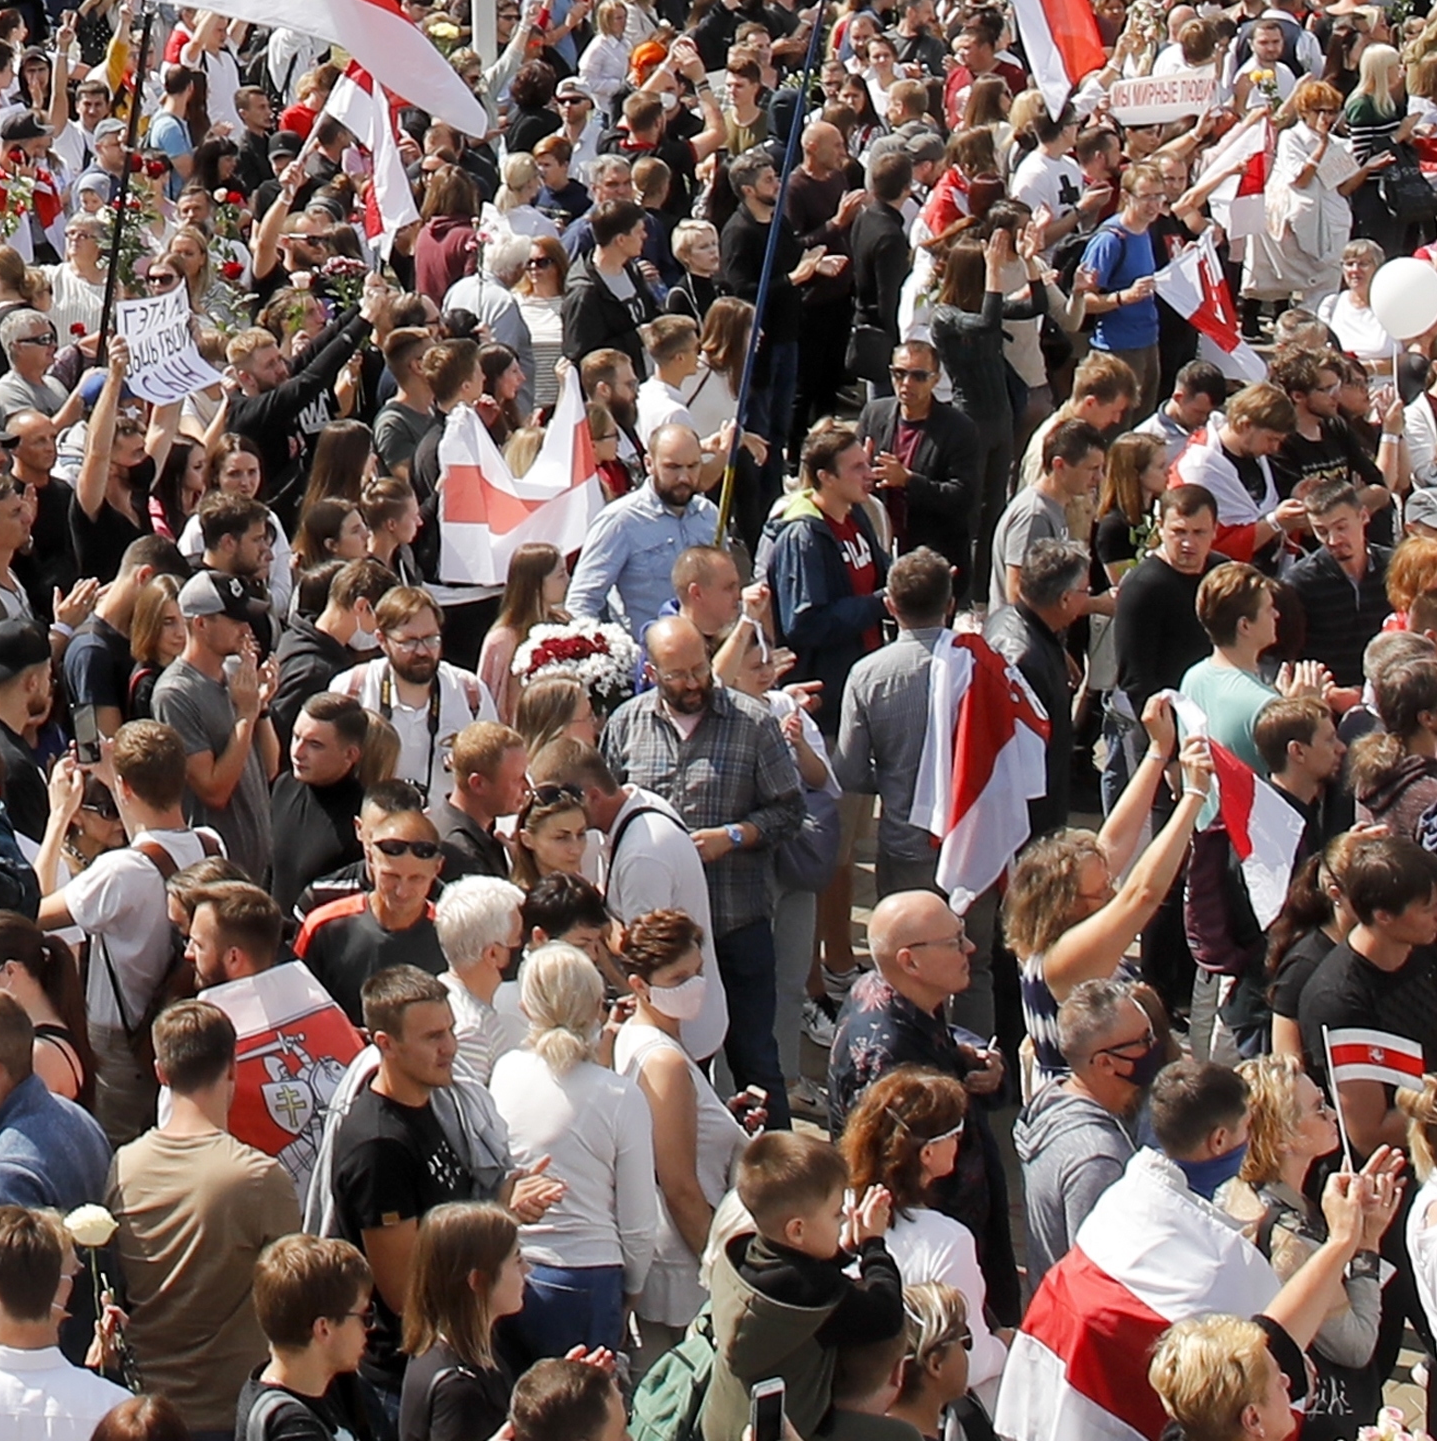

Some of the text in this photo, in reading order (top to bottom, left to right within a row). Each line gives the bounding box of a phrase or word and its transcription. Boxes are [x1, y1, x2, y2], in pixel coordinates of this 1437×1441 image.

[1113, 86, 1128, 108] МЫ
[1133, 81, 1178, 107] МИРНЫЕ
[123, 297, 167, 335] ГЭТА
[142, 356, 208, 399] СЫН
